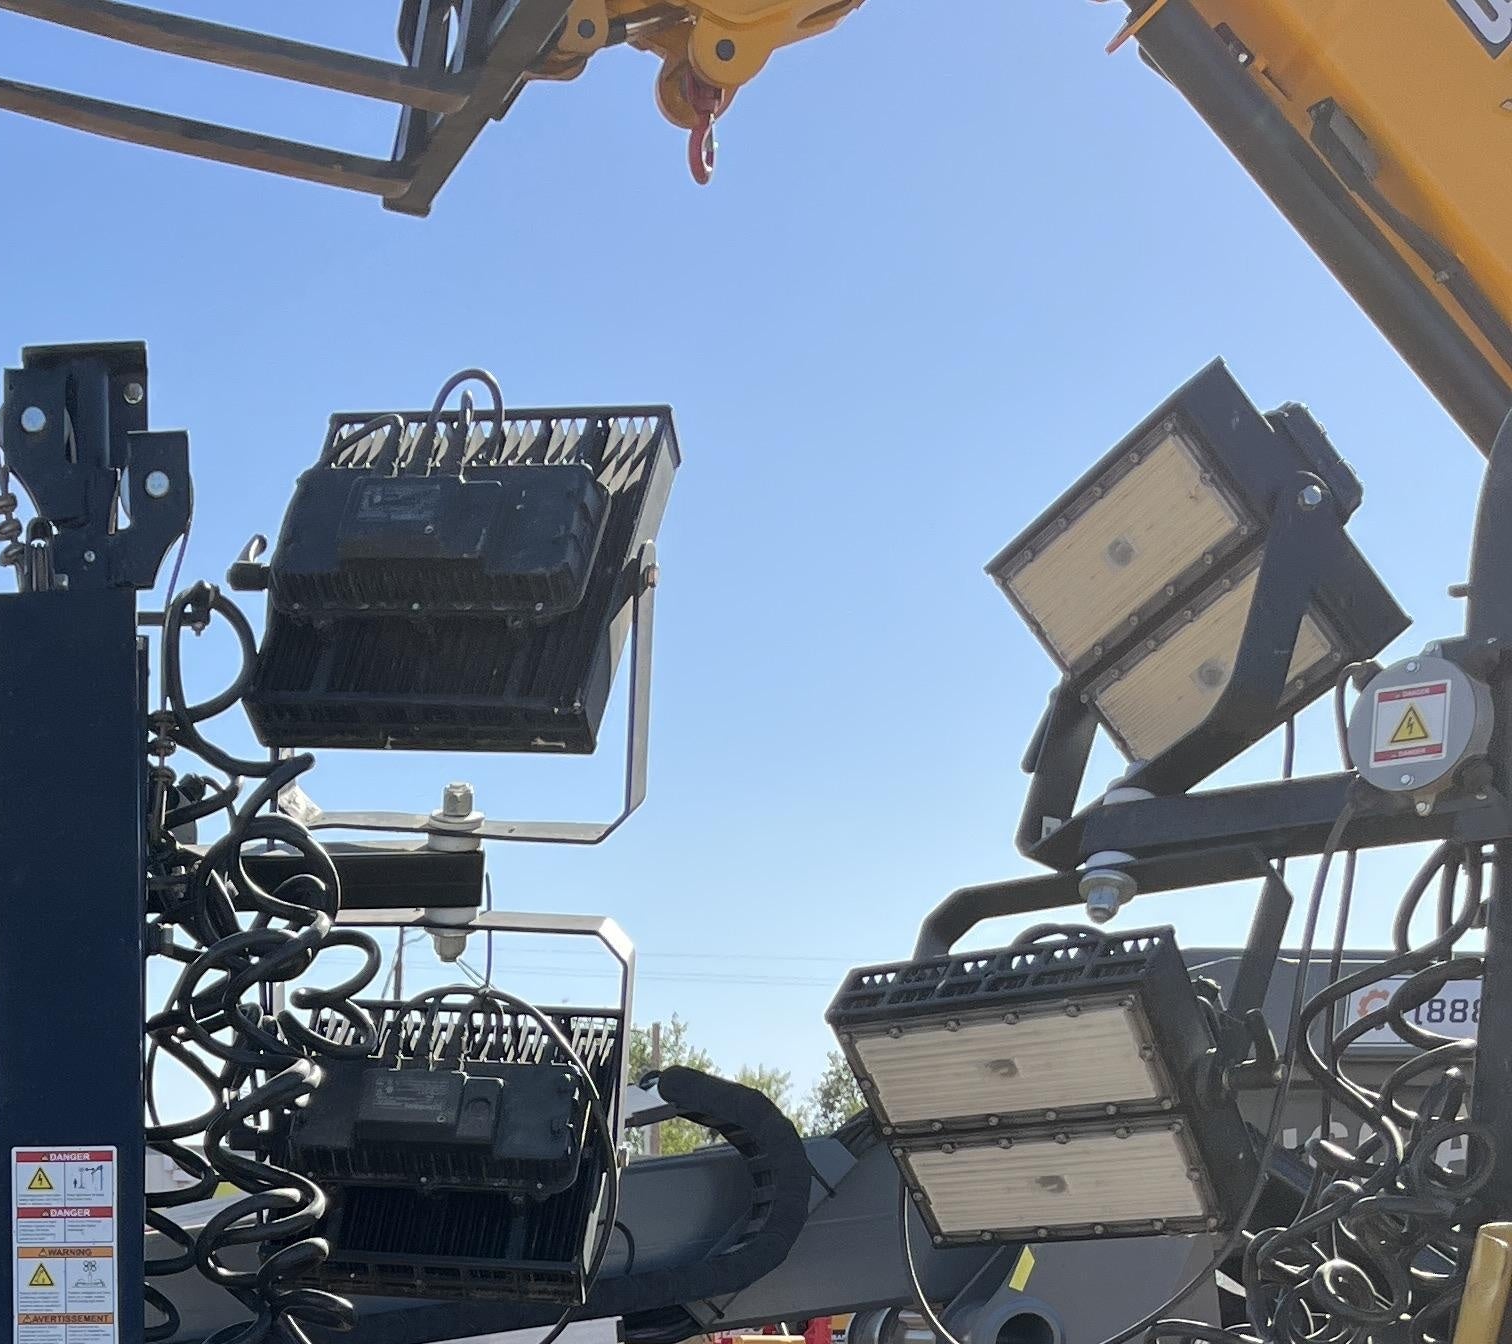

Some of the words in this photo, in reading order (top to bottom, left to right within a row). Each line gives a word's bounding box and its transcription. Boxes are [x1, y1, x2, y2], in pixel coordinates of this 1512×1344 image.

[49, 1152, 91, 1162] DANGER
[49, 1208, 91, 1218] DANGER
[47, 1248, 92, 1258] WARNING
[31, 1314, 110, 1324] AVERTISSEMENT
